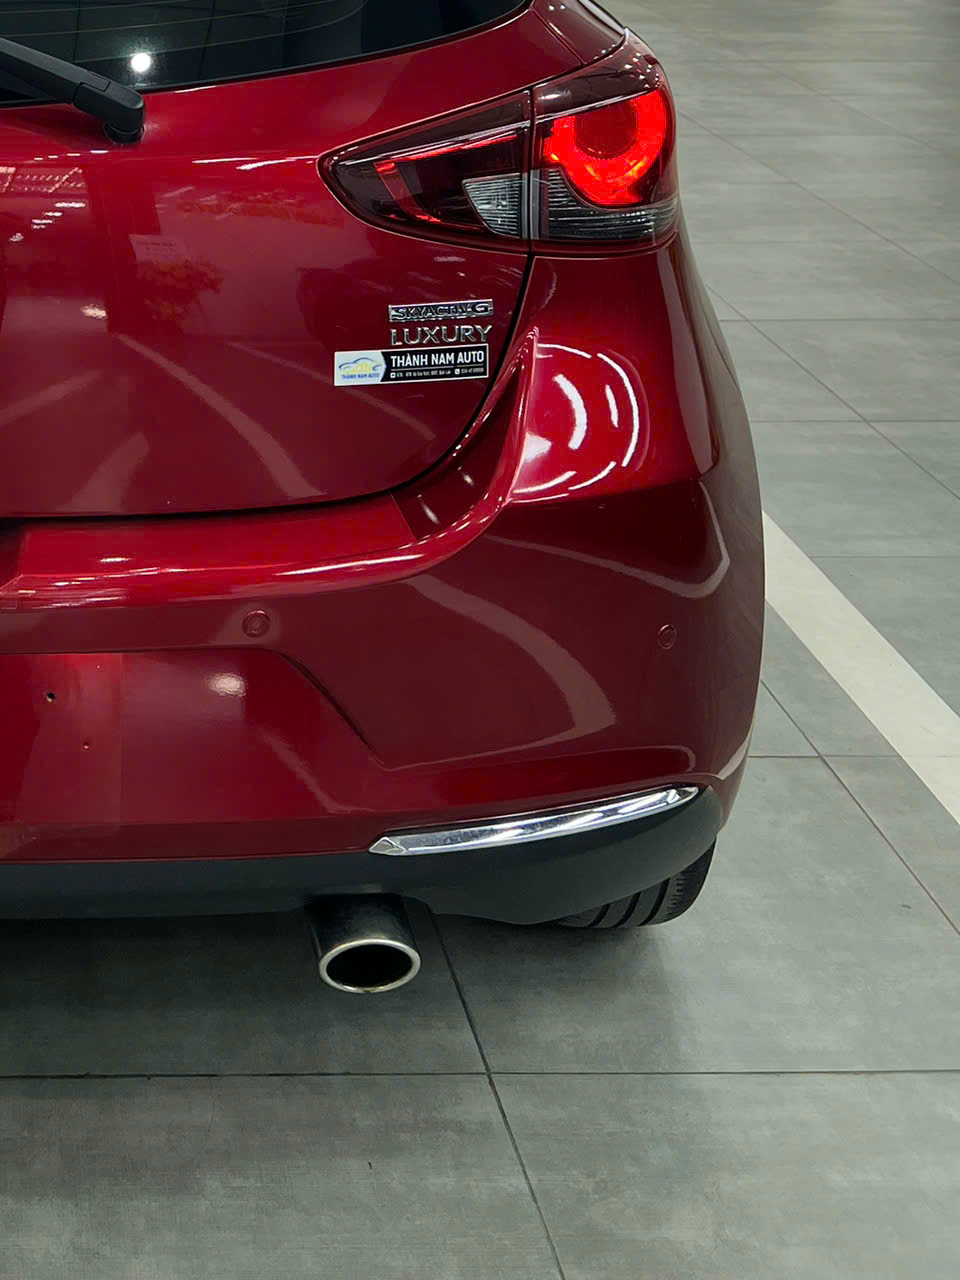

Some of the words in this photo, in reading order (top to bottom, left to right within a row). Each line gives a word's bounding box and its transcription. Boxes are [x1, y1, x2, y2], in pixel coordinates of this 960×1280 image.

[391, 325, 492, 345] LUXURY
[391, 352, 428, 368] THÀNH
[431, 351, 455, 365] NAM
[457, 350, 485, 364] AUTO
